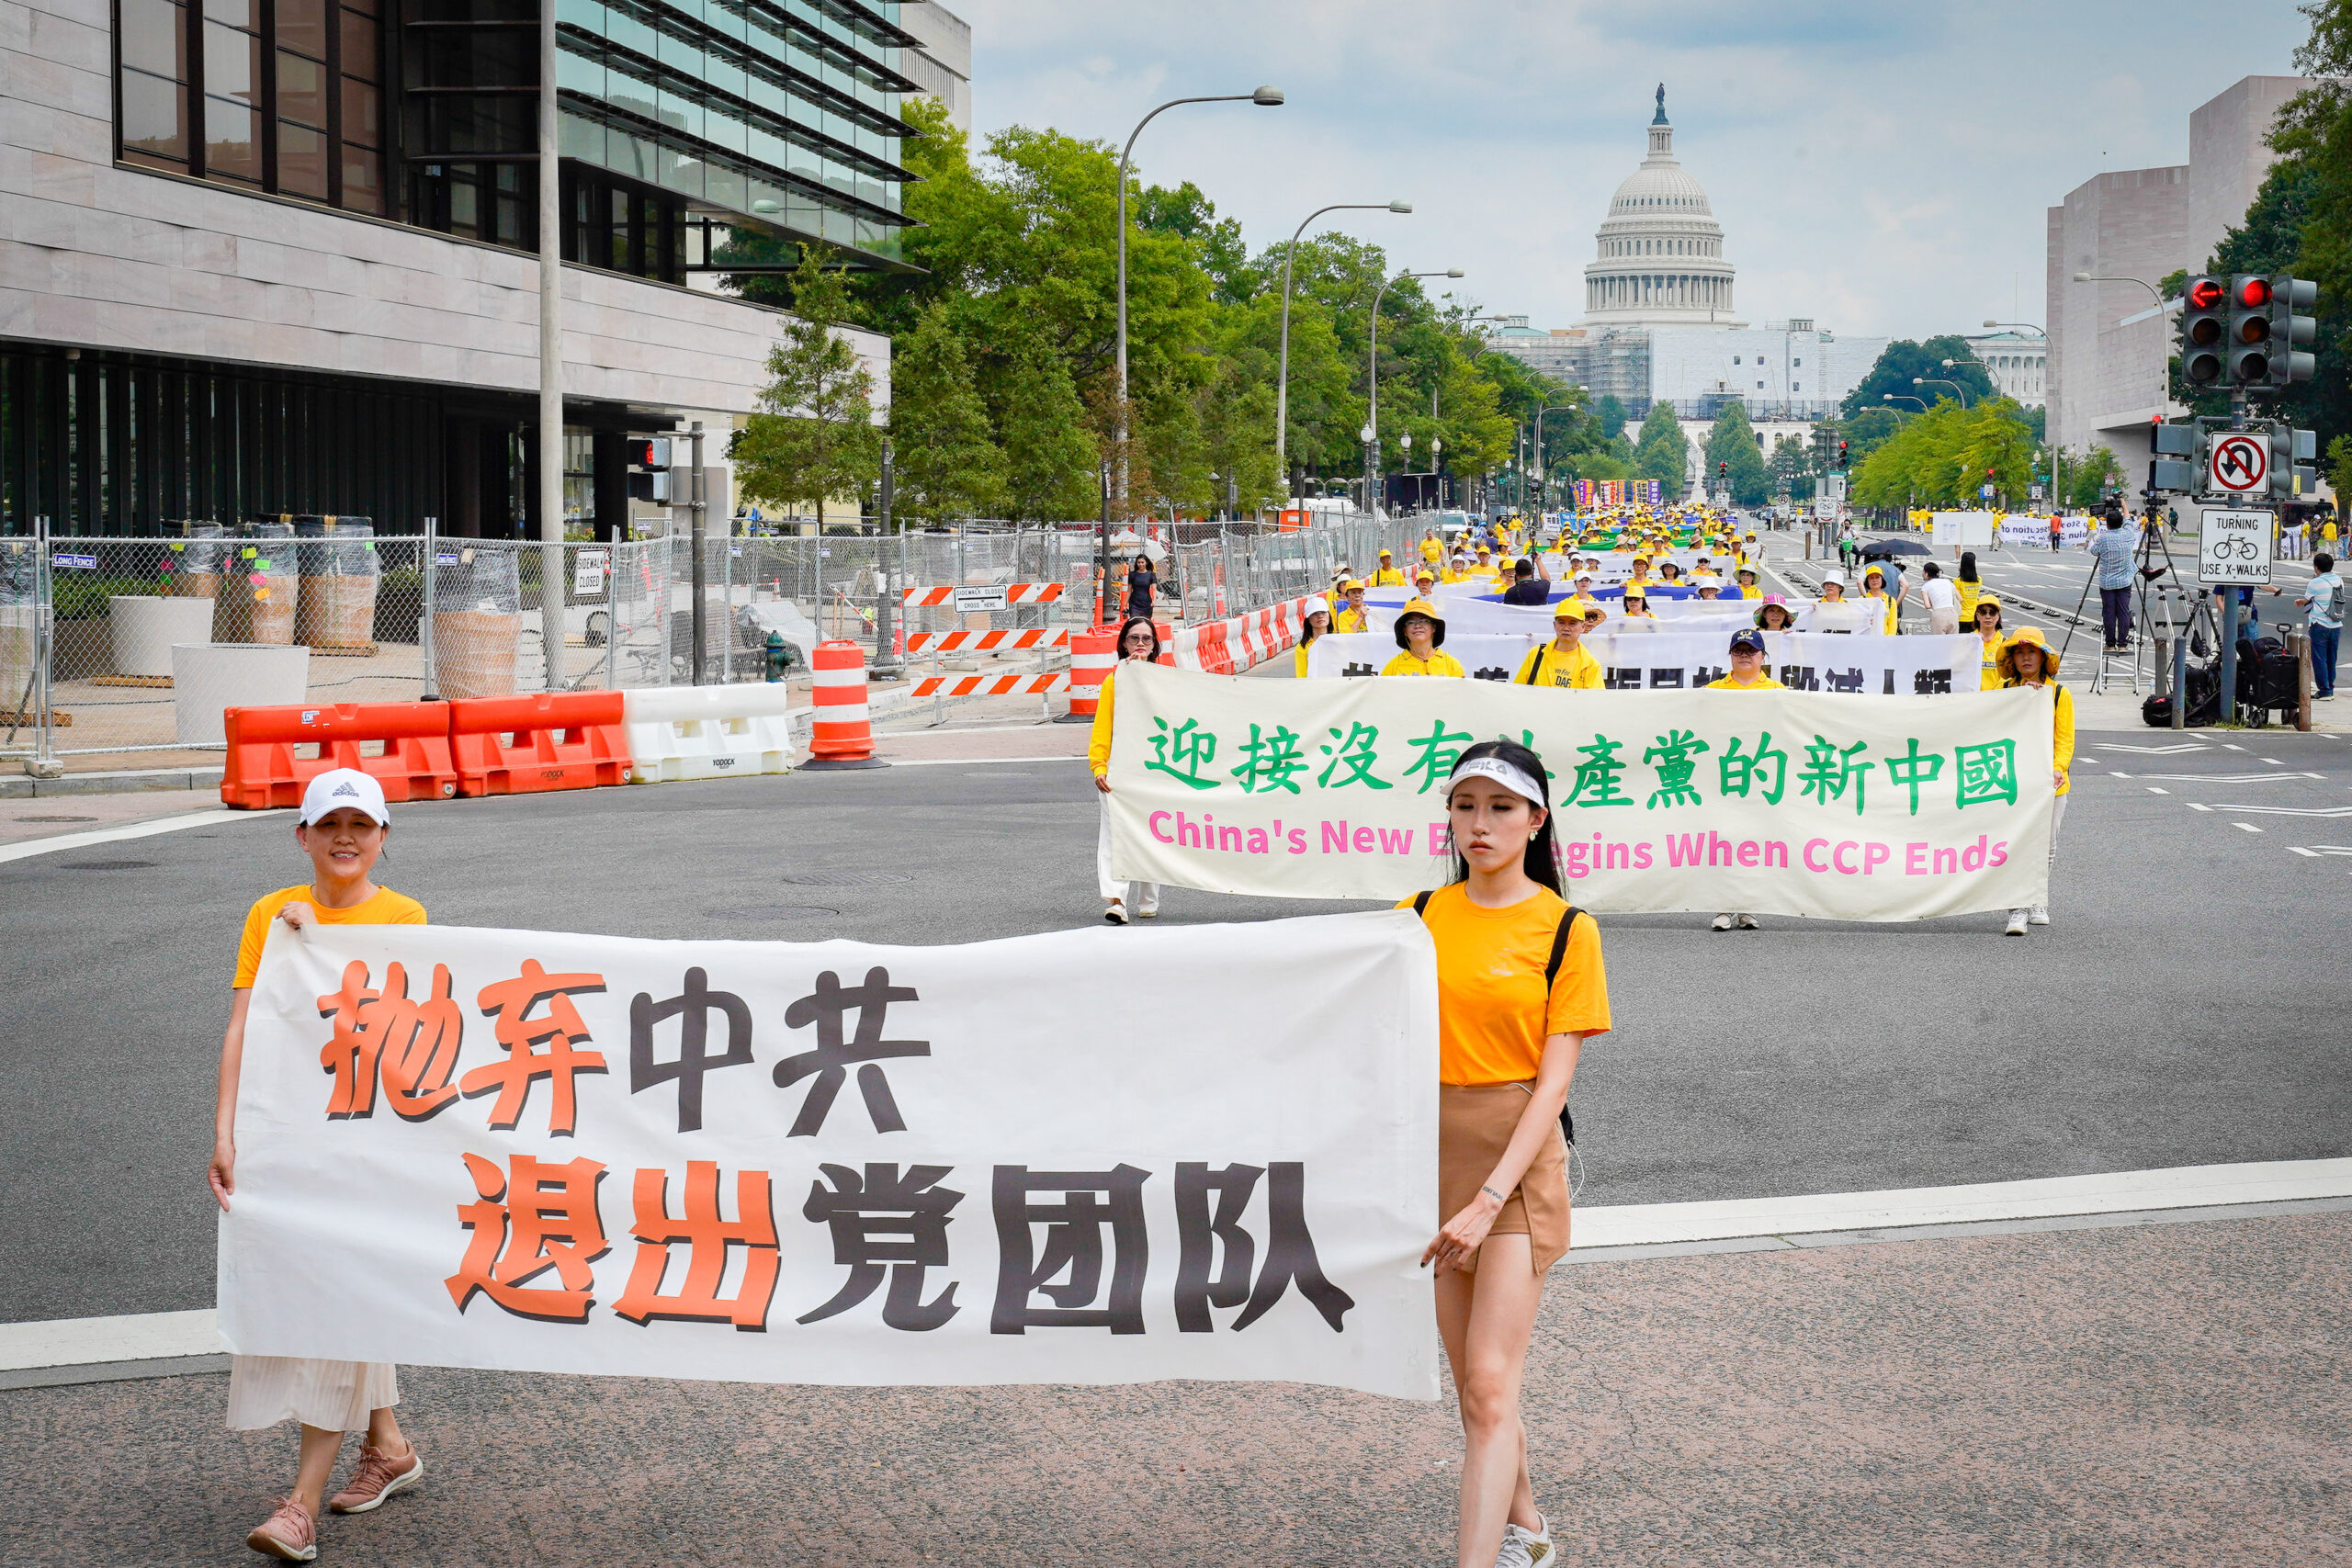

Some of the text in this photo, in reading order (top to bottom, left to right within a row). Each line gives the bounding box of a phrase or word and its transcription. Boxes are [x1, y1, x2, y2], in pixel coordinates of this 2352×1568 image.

[2216, 517, 2258, 531] TURNING
[55, 555, 94, 567] LONG FENCE
[578, 558, 603, 569] SIDEWALK
[2201, 563, 2268, 577] USE X-WALKS
[579, 575, 600, 588] CLOSED
[712, 758, 735, 766] YODOCK
[1148, 809, 1307, 855] China's
[1321, 819, 1413, 855] New
[1551, 830, 1654, 879] gins
[1666, 829, 1789, 869] When
[1803, 837, 1891, 875] CCP
[1905, 834, 2008, 876] Ends
[444, 1151, 1355, 1334] 退出党团队
